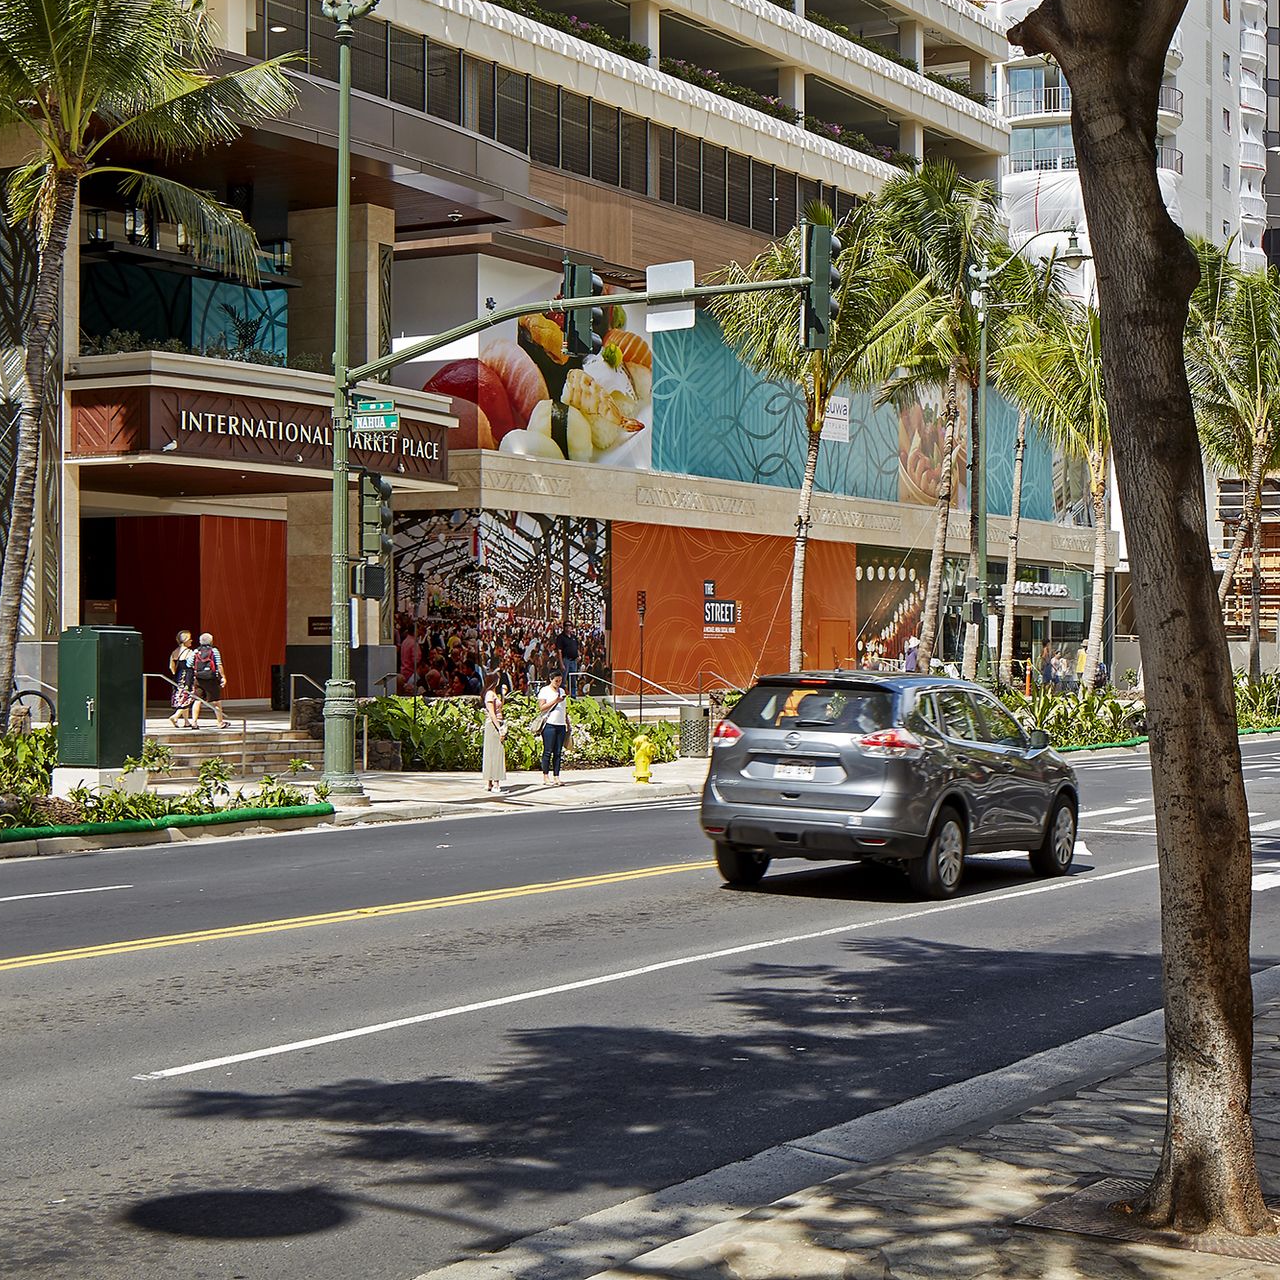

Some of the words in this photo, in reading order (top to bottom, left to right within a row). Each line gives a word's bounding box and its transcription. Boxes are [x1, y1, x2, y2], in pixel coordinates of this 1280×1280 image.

[826, 403, 847, 415] suwa
[356, 416, 386, 428] NAHUA
[181, 410, 332, 446] INTERNATIONAL
[402, 437, 439, 460] PLACE
[704, 583, 714, 595] THE
[1014, 581, 1034, 595] ABC
[1034, 582, 1068, 597] STORES
[705, 602, 734, 623] STREET
